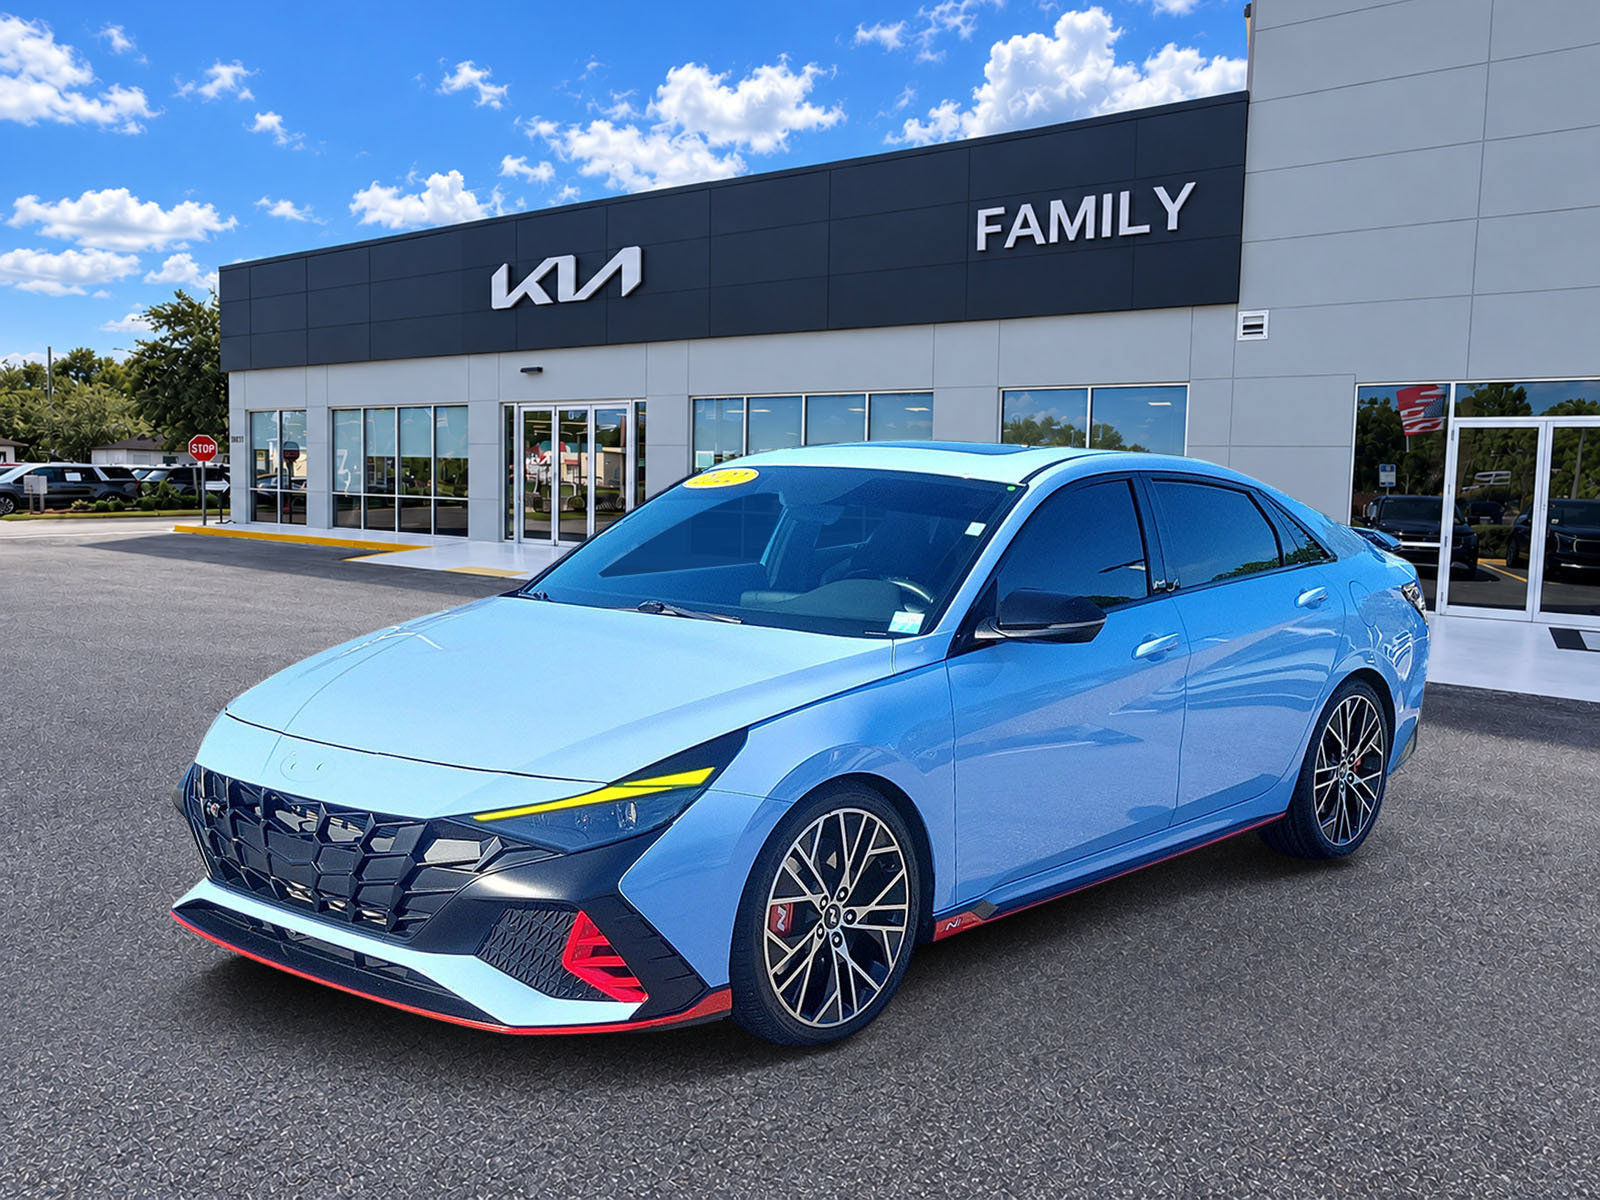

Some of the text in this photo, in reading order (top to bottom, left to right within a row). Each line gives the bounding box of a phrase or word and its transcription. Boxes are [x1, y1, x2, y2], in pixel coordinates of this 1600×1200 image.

[976, 181, 1197, 252] FAMILY
[490, 245, 642, 310] KIA
[191, 443, 215, 454] STOP
